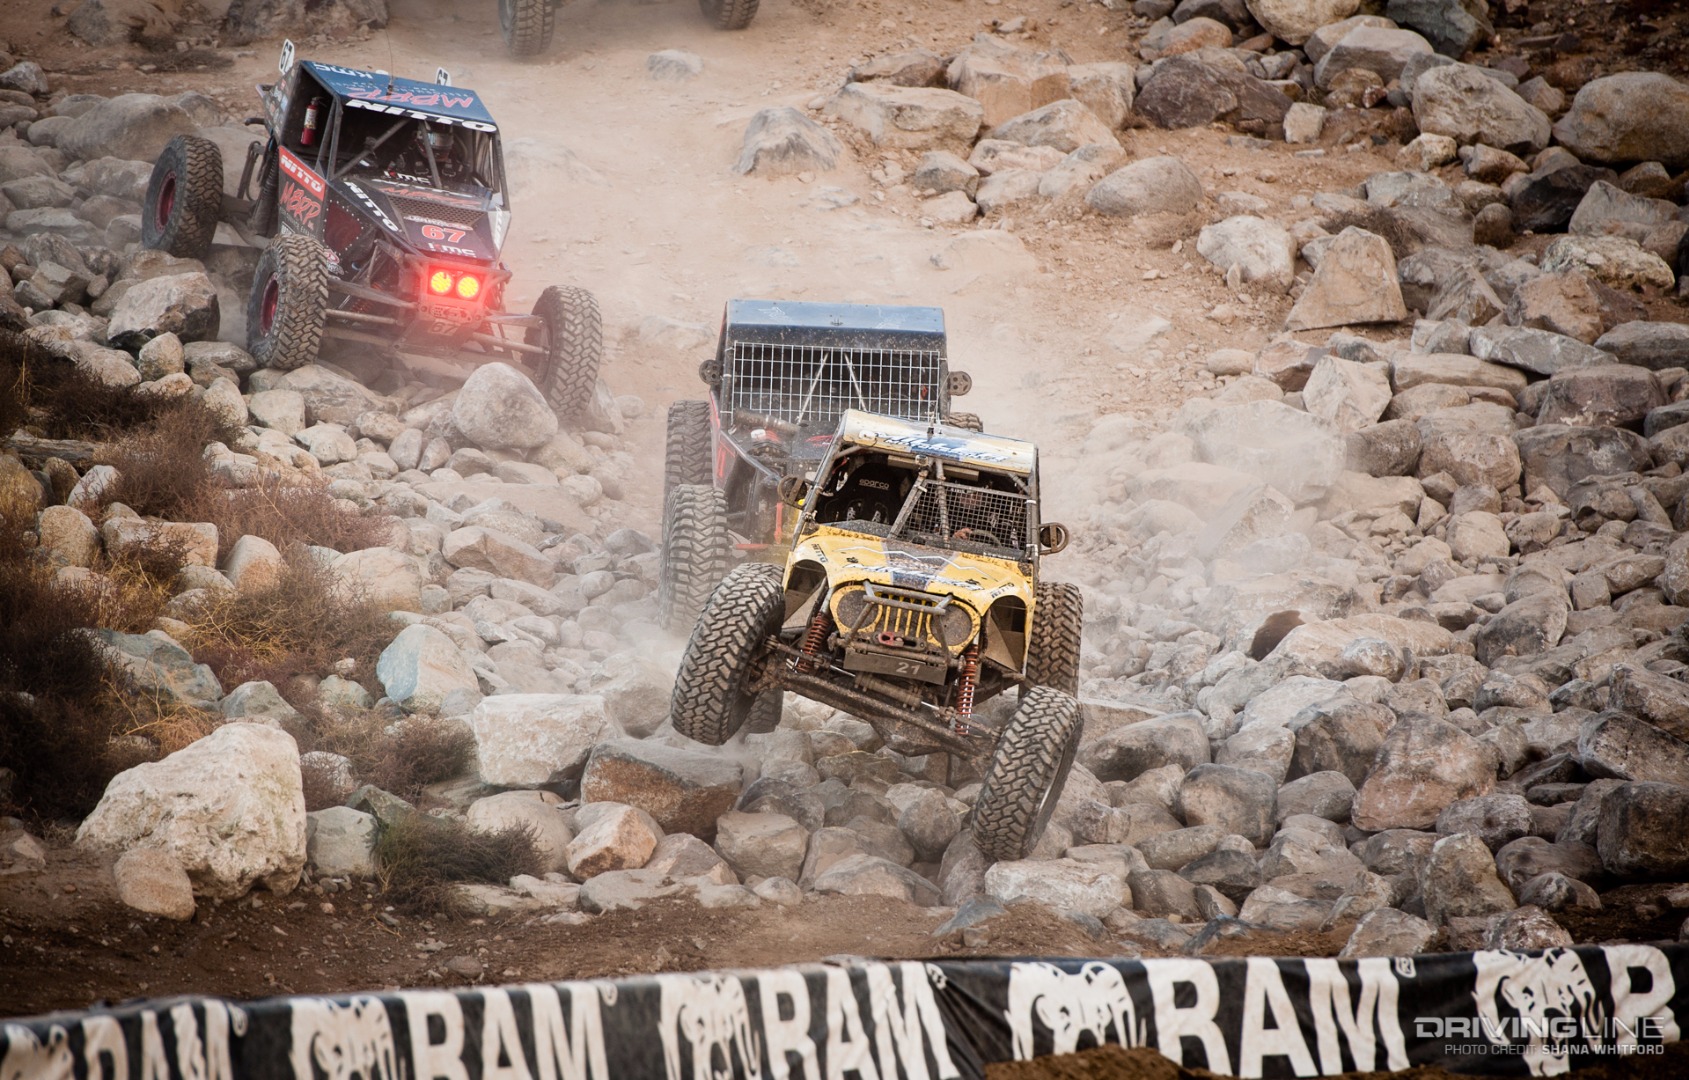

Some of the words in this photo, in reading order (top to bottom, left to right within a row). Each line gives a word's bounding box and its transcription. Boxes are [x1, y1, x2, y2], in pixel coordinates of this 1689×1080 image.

[346, 99, 497, 133] NITTO
[281, 155, 322, 193] NITTO
[280, 181, 321, 225] MBRP
[343, 181, 399, 232] NITTO
[422, 224, 466, 244] 67
[431, 321, 460, 336] 67
[859, 479, 890, 491] sparco
[896, 661, 921, 676] 21
[400, 983, 611, 1080] RAM
[756, 959, 962, 1080] RAM
[1140, 956, 1412, 1079] RAM
